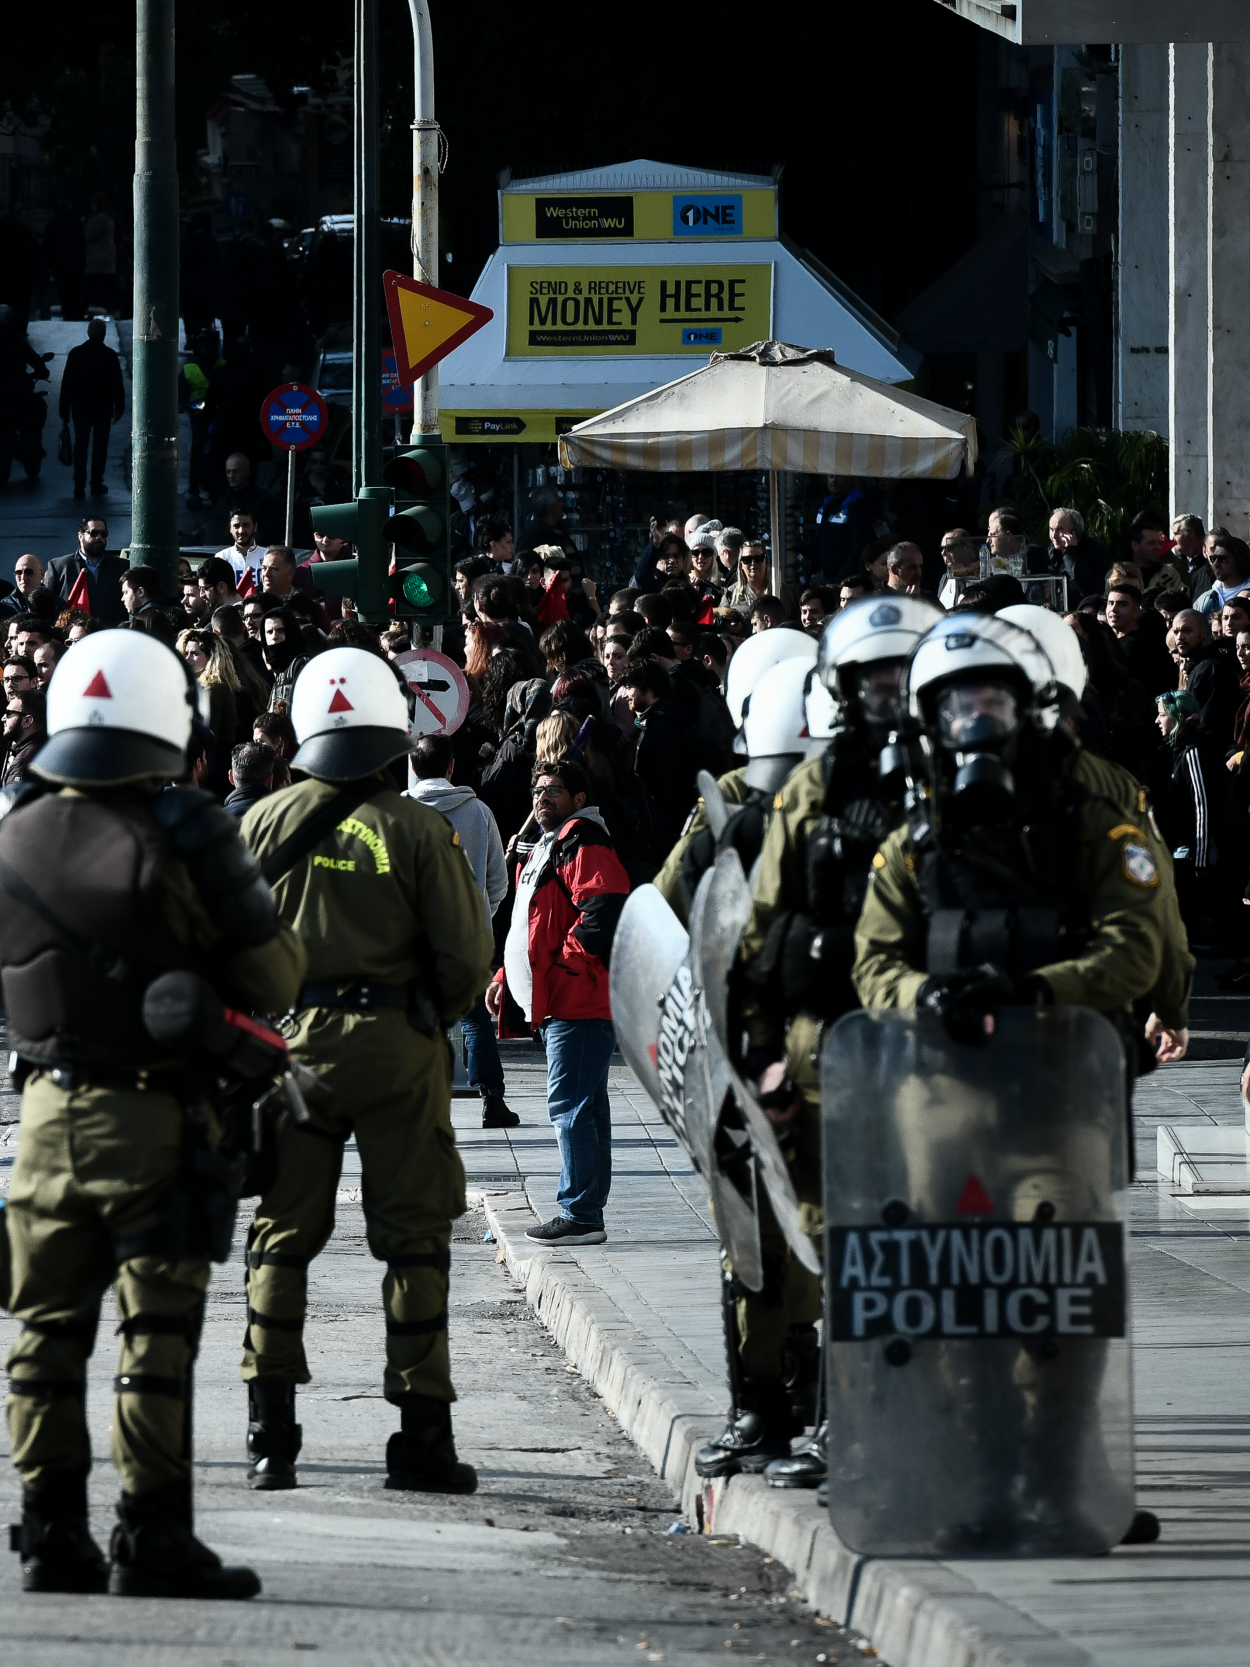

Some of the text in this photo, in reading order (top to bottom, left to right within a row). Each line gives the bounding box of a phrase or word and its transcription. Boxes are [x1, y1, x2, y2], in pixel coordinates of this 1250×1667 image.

[545, 206, 599, 218] Western
[529, 279, 746, 312] SEND & RECEIVE HERE
[528, 296, 645, 326] MONEY
[484, 421, 518, 431] PayLink
[313, 855, 356, 872] POLICE
[839, 1227, 1108, 1288] ΑΣΤΥΝΟΜΙΑ
[851, 1287, 1096, 1338] POLICE
